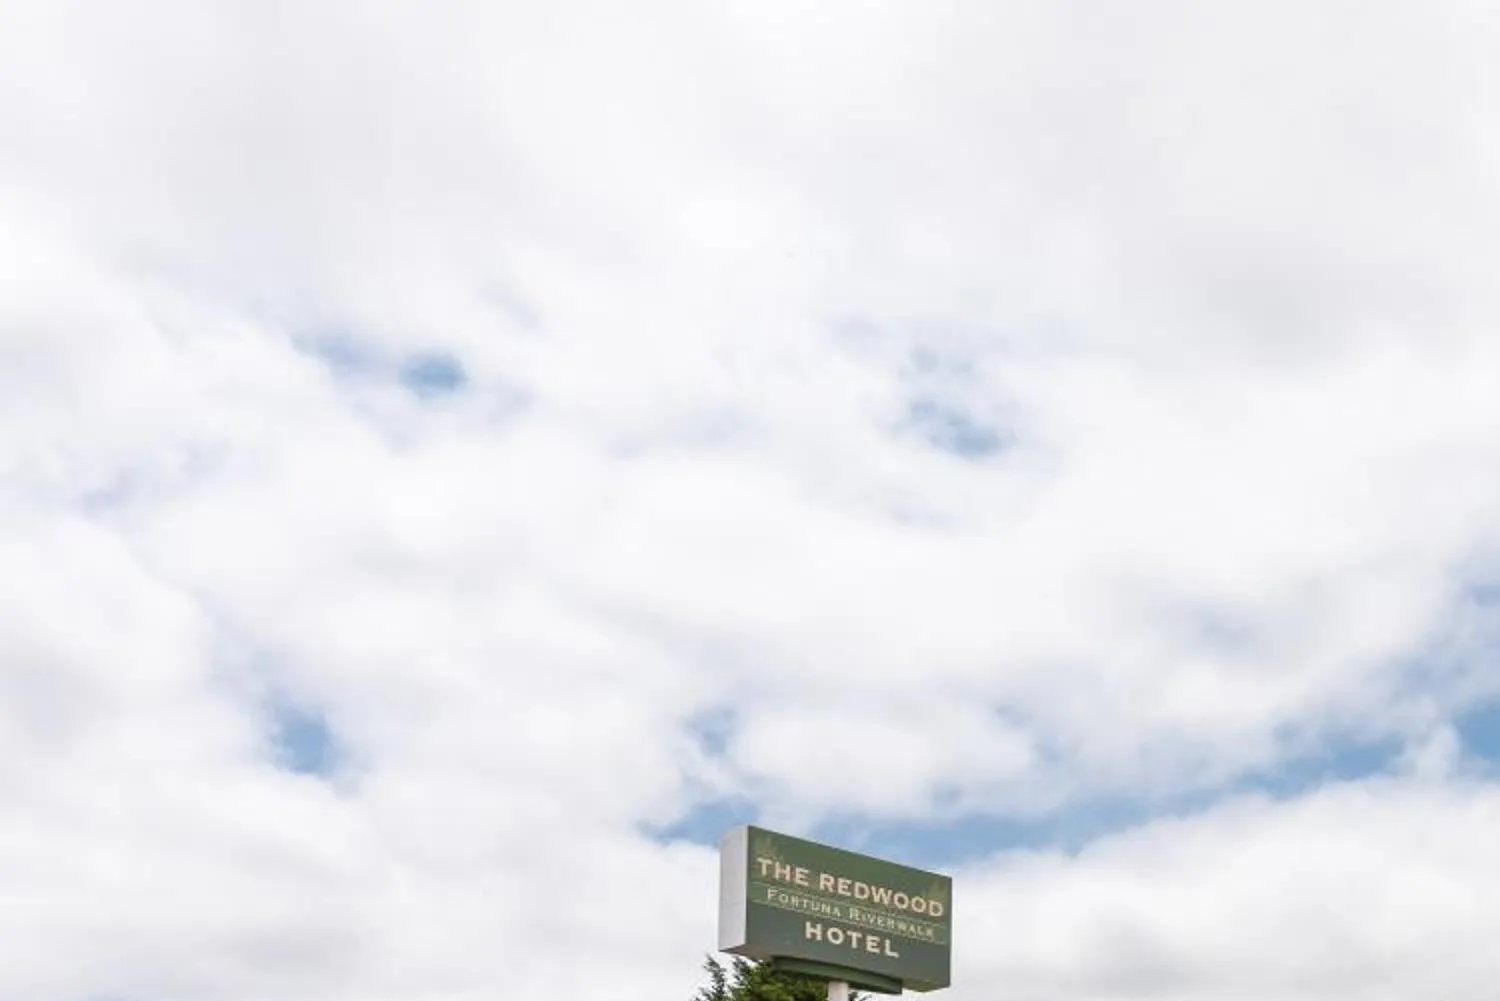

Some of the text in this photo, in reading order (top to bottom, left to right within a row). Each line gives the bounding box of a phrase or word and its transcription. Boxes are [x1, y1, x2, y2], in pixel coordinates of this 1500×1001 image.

[756, 857, 944, 917] THE REDWOOD
[767, 888, 842, 918] FORTUNA
[805, 921, 900, 958] HOTEL
